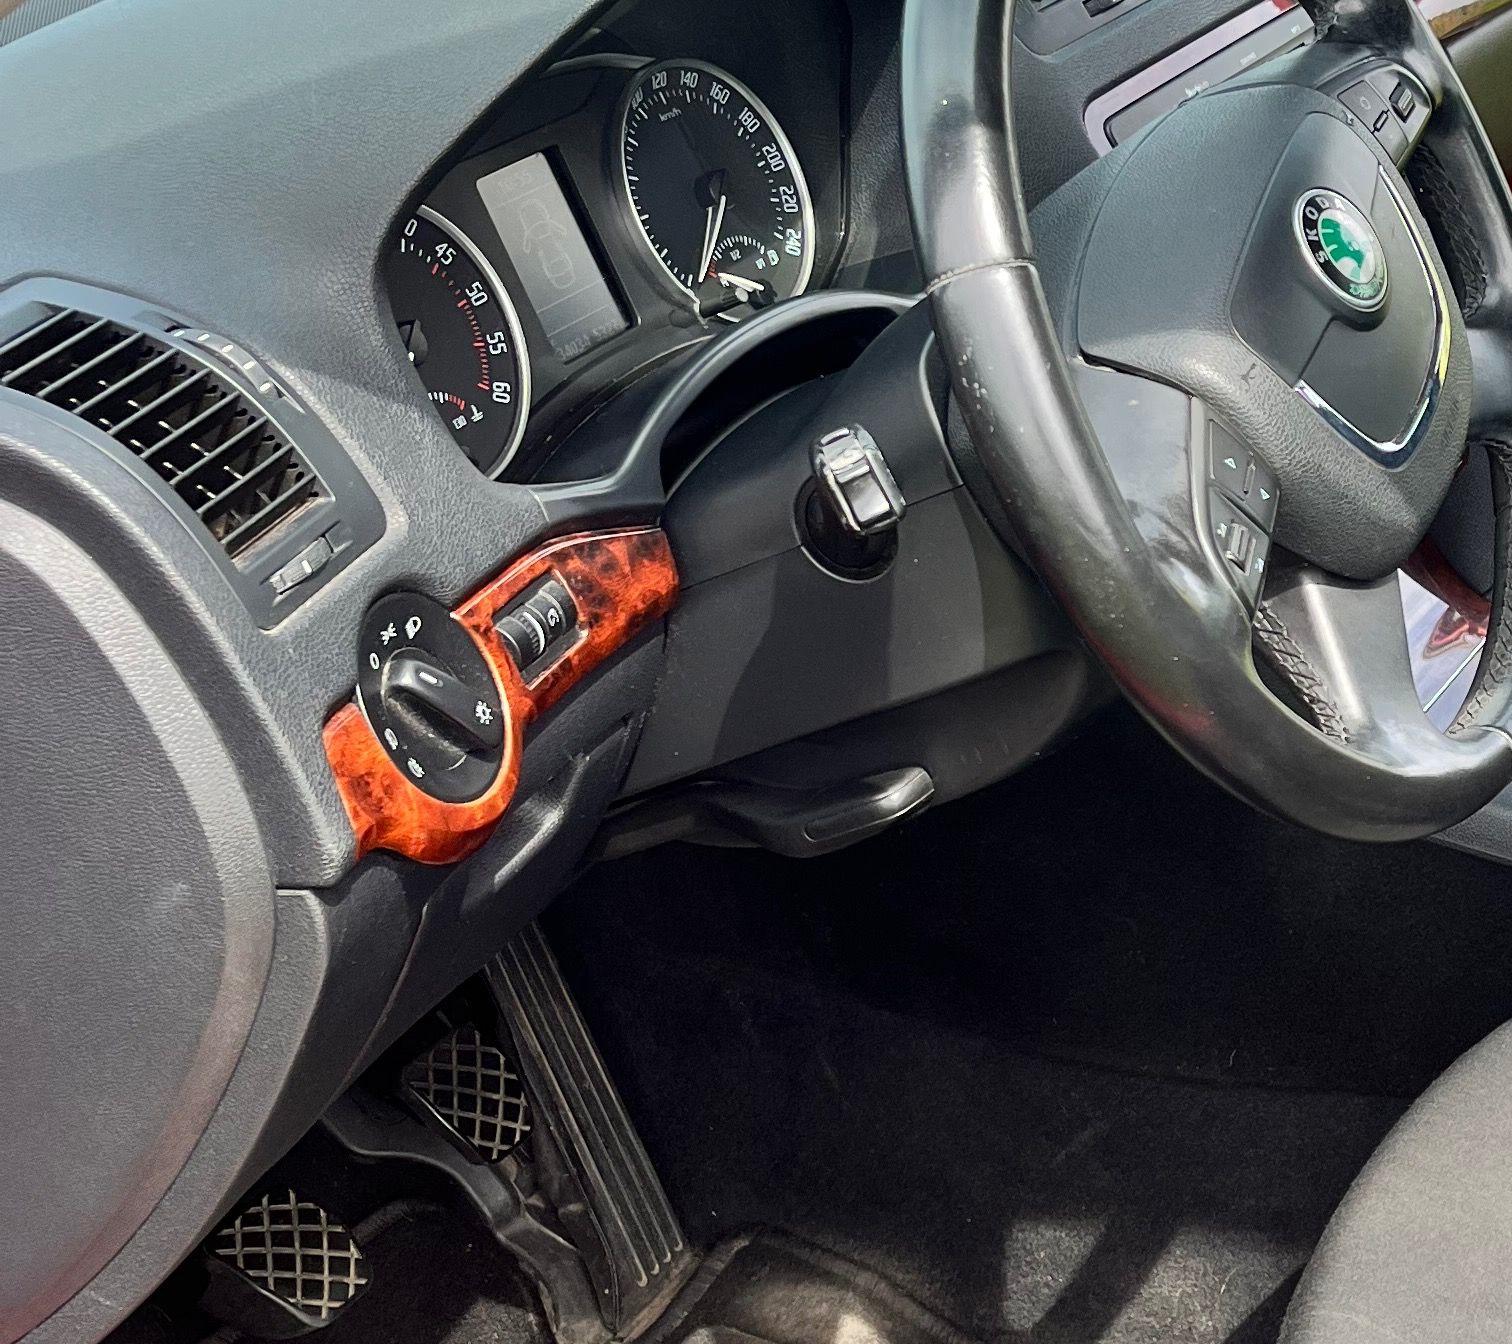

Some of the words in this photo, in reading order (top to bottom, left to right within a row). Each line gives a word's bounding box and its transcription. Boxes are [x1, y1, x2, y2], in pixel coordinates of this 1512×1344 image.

[652, 71, 667, 89] 120
[680, 70, 699, 88] 140
[709, 82, 731, 104] 160
[658, 107, 682, 122] km/h
[738, 107, 761, 133] 180
[762, 142, 785, 172] 200
[779, 185, 799, 213] 220
[435, 243, 457, 265] 45
[785, 228, 802, 257] 240
[465, 281, 489, 307] 50
[486, 331, 508, 355] 55
[492, 381, 511, 404] 60
